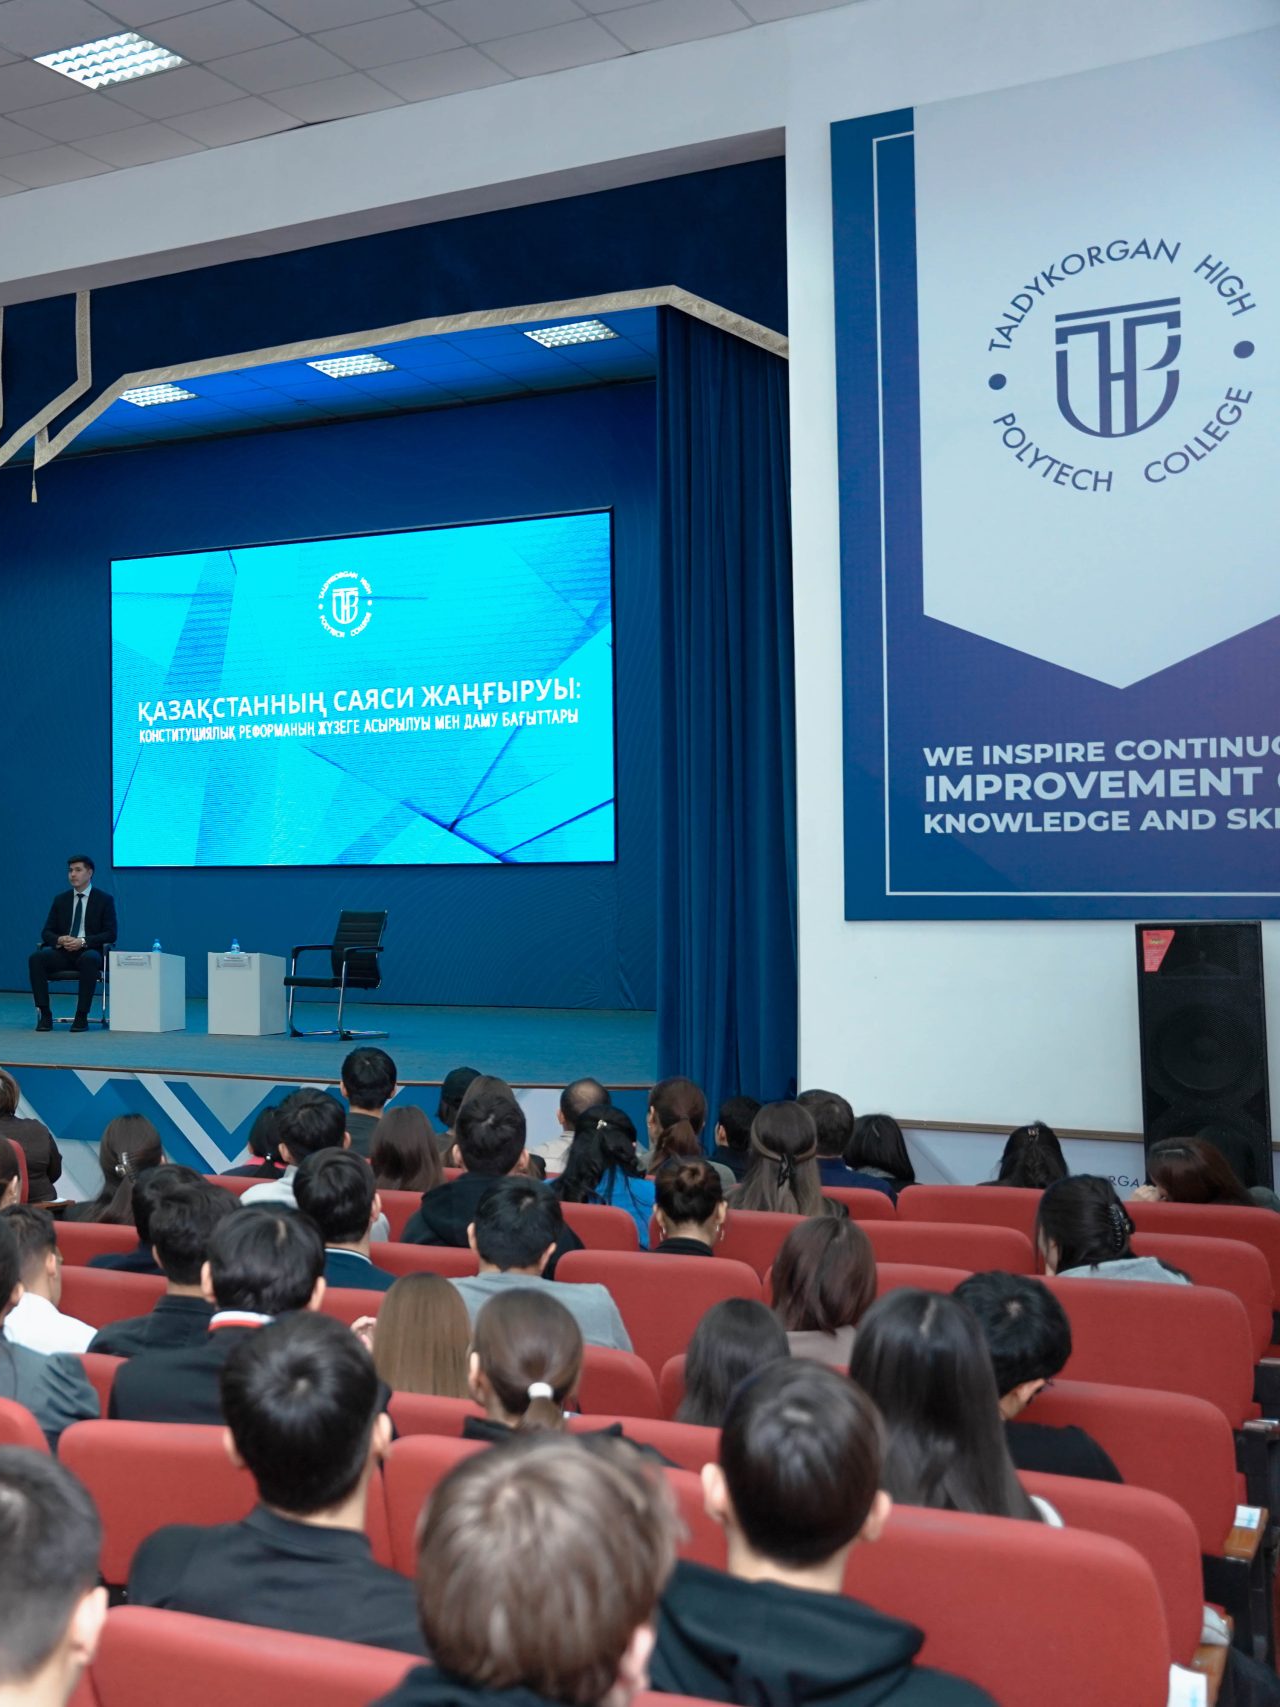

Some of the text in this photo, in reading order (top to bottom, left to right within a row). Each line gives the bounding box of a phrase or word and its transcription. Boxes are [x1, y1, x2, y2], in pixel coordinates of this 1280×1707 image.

[988, 237, 1257, 352] TALDYKORGAN HIGH
[992, 387, 1253, 492] POLYTECH COLLEGE
[138, 677, 581, 725] ҚАЗАҚСТАННЫҢ САЯСИ ЖАҢҒЫРУЫ:
[364, 716, 431, 733] АСЫРЫЛУЫ
[435, 714, 460, 730] МЕН
[464, 711, 497, 730] ДАМУ
[502, 708, 579, 727] БАҒЫТТАРЫ
[923, 746, 973, 766] WE
[983, 741, 1105, 765] INSPIRE
[925, 766, 1263, 802] IMPROVEMENT
[924, 811, 1131, 834] KNOWLEDGE
[1139, 808, 1217, 831] AND
